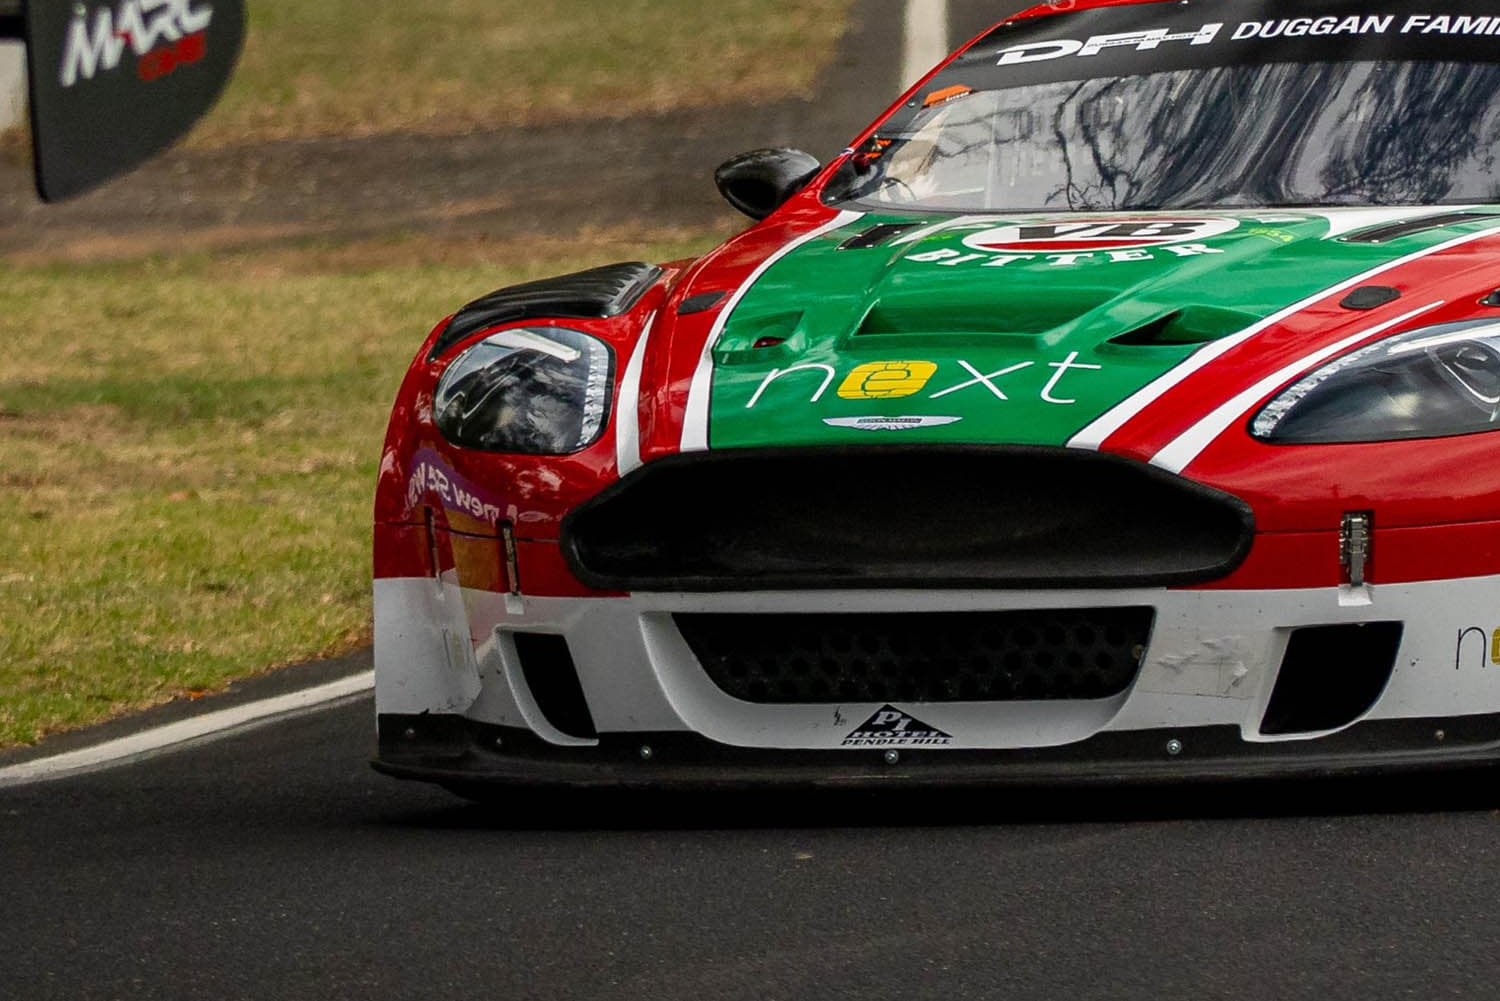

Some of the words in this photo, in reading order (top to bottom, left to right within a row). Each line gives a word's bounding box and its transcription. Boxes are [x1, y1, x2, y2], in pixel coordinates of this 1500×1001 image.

[1230, 15, 1396, 41] DUGGAN
[996, 22, 1225, 66] DFH
[1018, 221, 1207, 240] VB
[904, 243, 1226, 267] BITTER
[746, 351, 1101, 408] next
